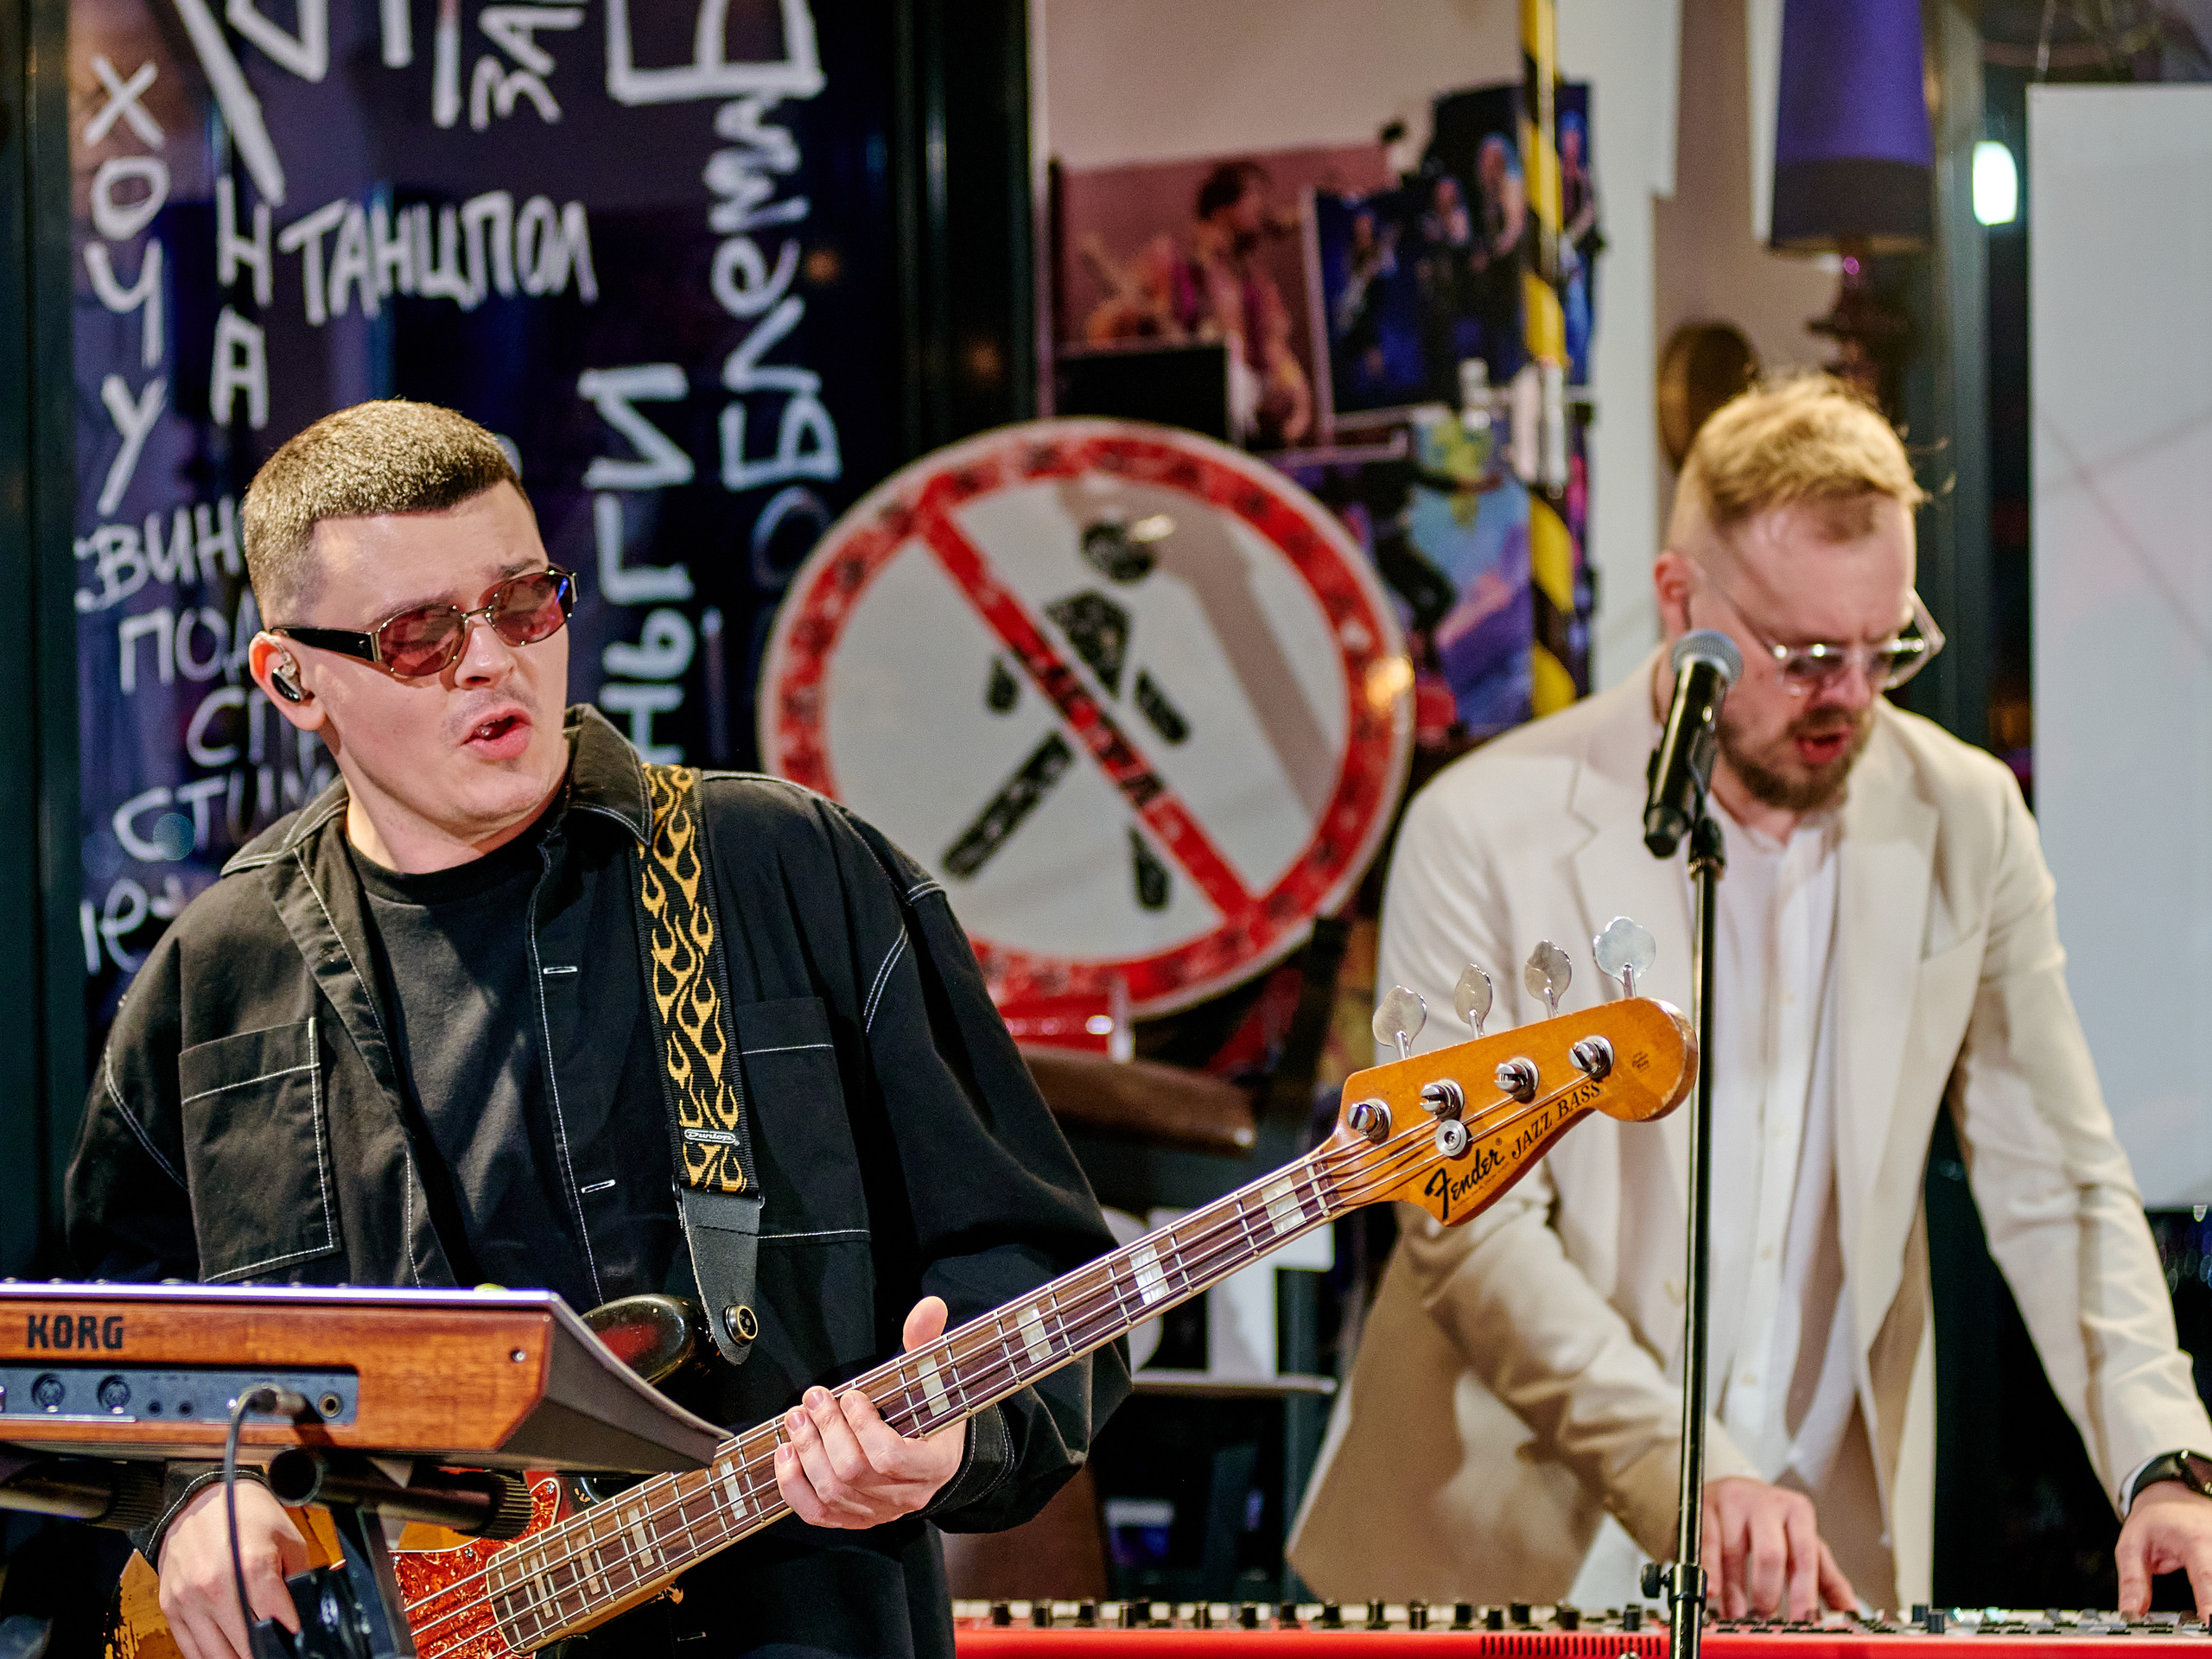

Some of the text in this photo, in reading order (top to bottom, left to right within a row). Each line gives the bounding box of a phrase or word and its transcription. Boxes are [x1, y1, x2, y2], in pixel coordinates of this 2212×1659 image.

[84, 55, 170, 516] ХОЧУ
[73, 495, 246, 613] ВИН
[686, 1130, 734, 1141] Dunlop
[1511, 1082, 1602, 1160] JAZZ BASS
[1424, 1147, 1505, 1221] Fender
[28, 1314, 124, 1349] KORG
